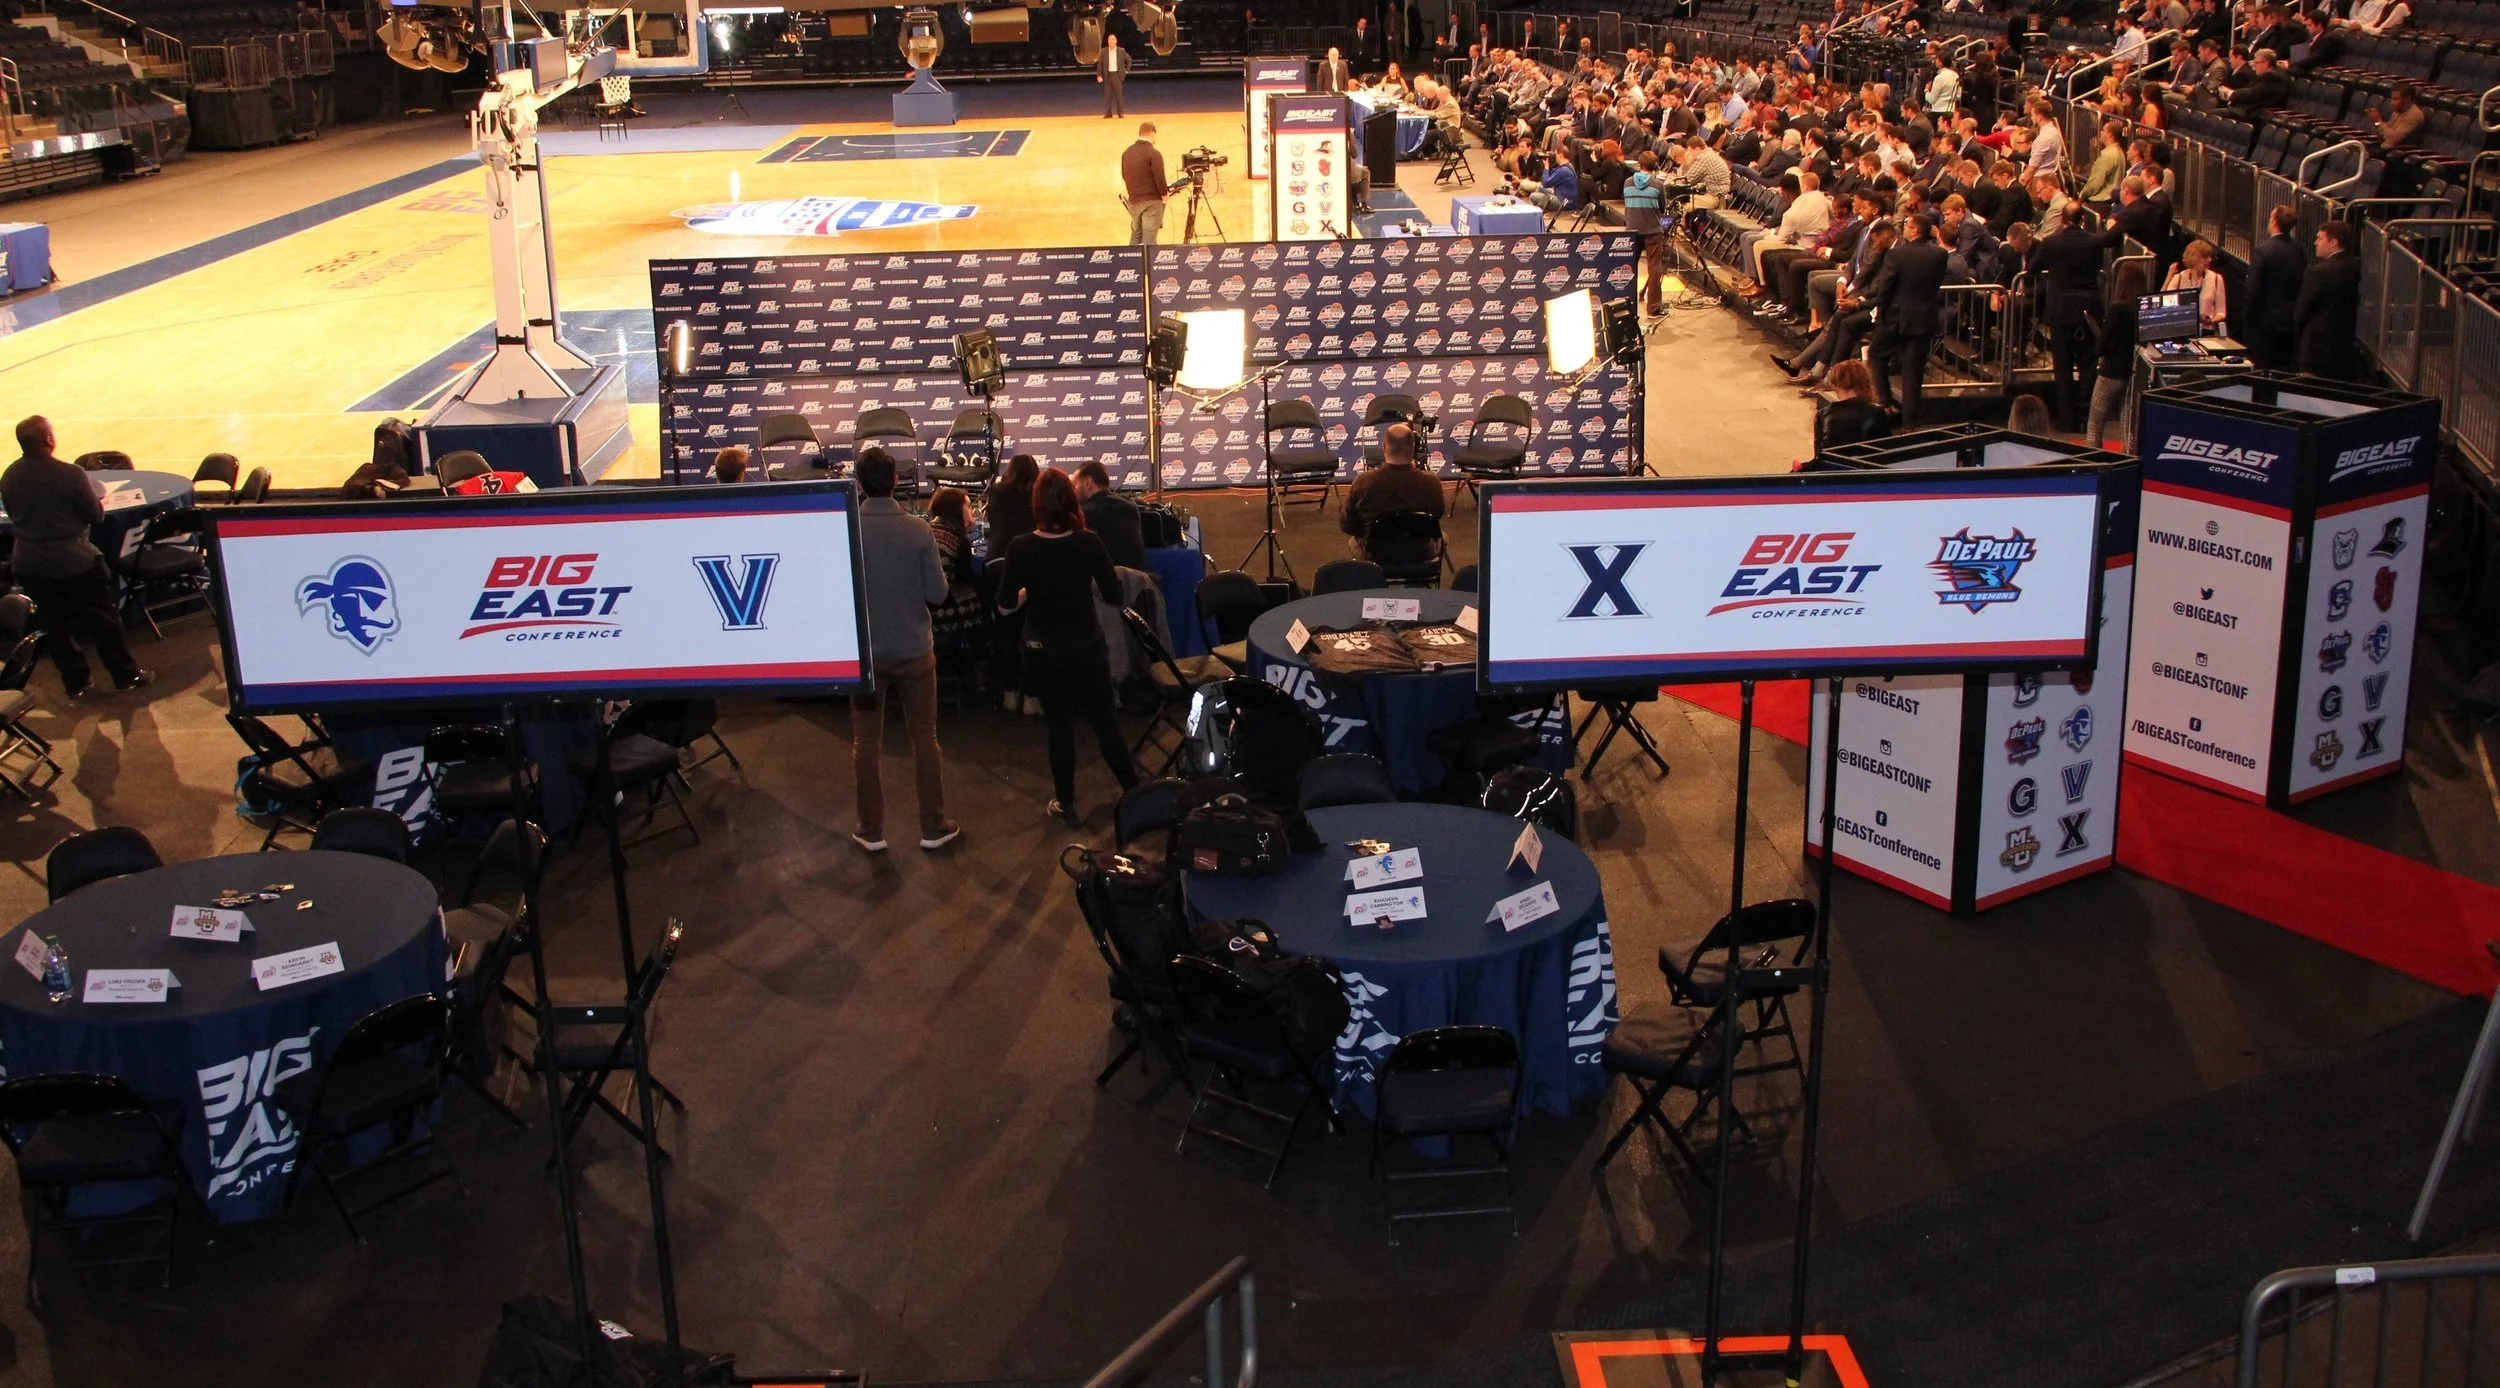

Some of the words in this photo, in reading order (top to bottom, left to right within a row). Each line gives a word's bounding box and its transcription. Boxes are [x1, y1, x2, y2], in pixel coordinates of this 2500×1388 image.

[2208, 465, 2270, 483] CONFERENCE
[1740, 532, 1856, 566] BIG
[2148, 529, 2273, 571] WWW.BIGEAST.COM
[484, 553, 599, 588] BIG
[1563, 541, 1649, 620] X
[1720, 564, 1882, 599] EAST
[471, 586, 633, 620] EAST
[693, 552, 780, 631] V
[1947, 593, 1974, 603] BLUE
[1976, 590, 2018, 602] DEMONS
[1752, 606, 1866, 619] CONFERENCE
[2173, 601, 2238, 630] @BIGEAST
[505, 629, 623, 643] CONFERENCE
[1333, 637, 1372, 652] 45
[1422, 632, 1466, 646] 30
[2151, 661, 2249, 700] @BIGEASTCONF
[2363, 671, 2389, 710] V
[1856, 683, 1920, 716] @BIGEAST
[2319, 684, 2344, 721] G
[2131, 719, 2256, 771] /BIGEASTconference
[2356, 716, 2385, 760] X
[1837, 748, 1932, 794] @BIGEASTCONF
[2062, 760, 2092, 803] V
[2008, 777, 2039, 816] G
[2056, 809, 2091, 857] X
